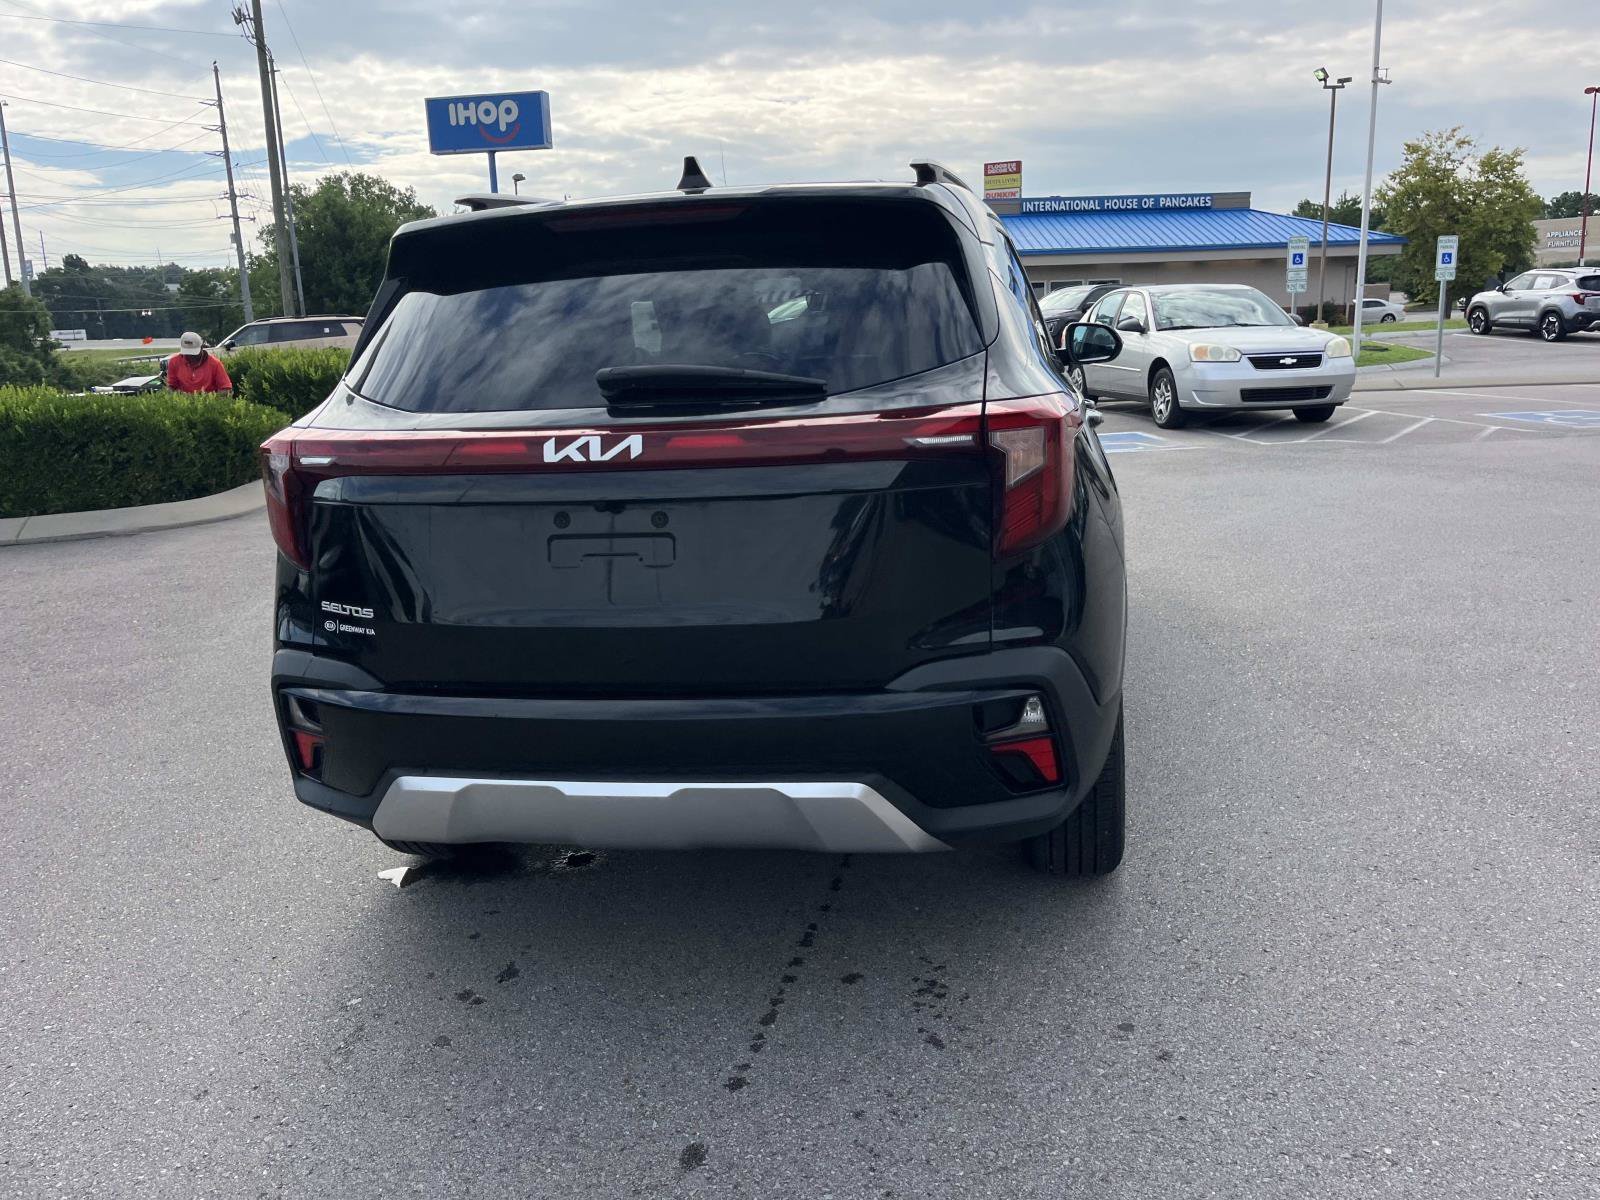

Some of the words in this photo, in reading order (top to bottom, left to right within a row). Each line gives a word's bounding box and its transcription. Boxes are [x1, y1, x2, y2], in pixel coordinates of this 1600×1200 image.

[448, 99, 519, 132] IHOP
[1022, 199, 1100, 213] INTERNATIONAL
[1104, 198, 1138, 211] HOUSE
[1141, 197, 1155, 209] OF
[1159, 196, 1212, 208] PANCAKES
[543, 434, 643, 463] KIA
[321, 600, 374, 619] SELTOS
[339, 624, 366, 634] GREENWAY
[366, 628, 376, 636] KIA
